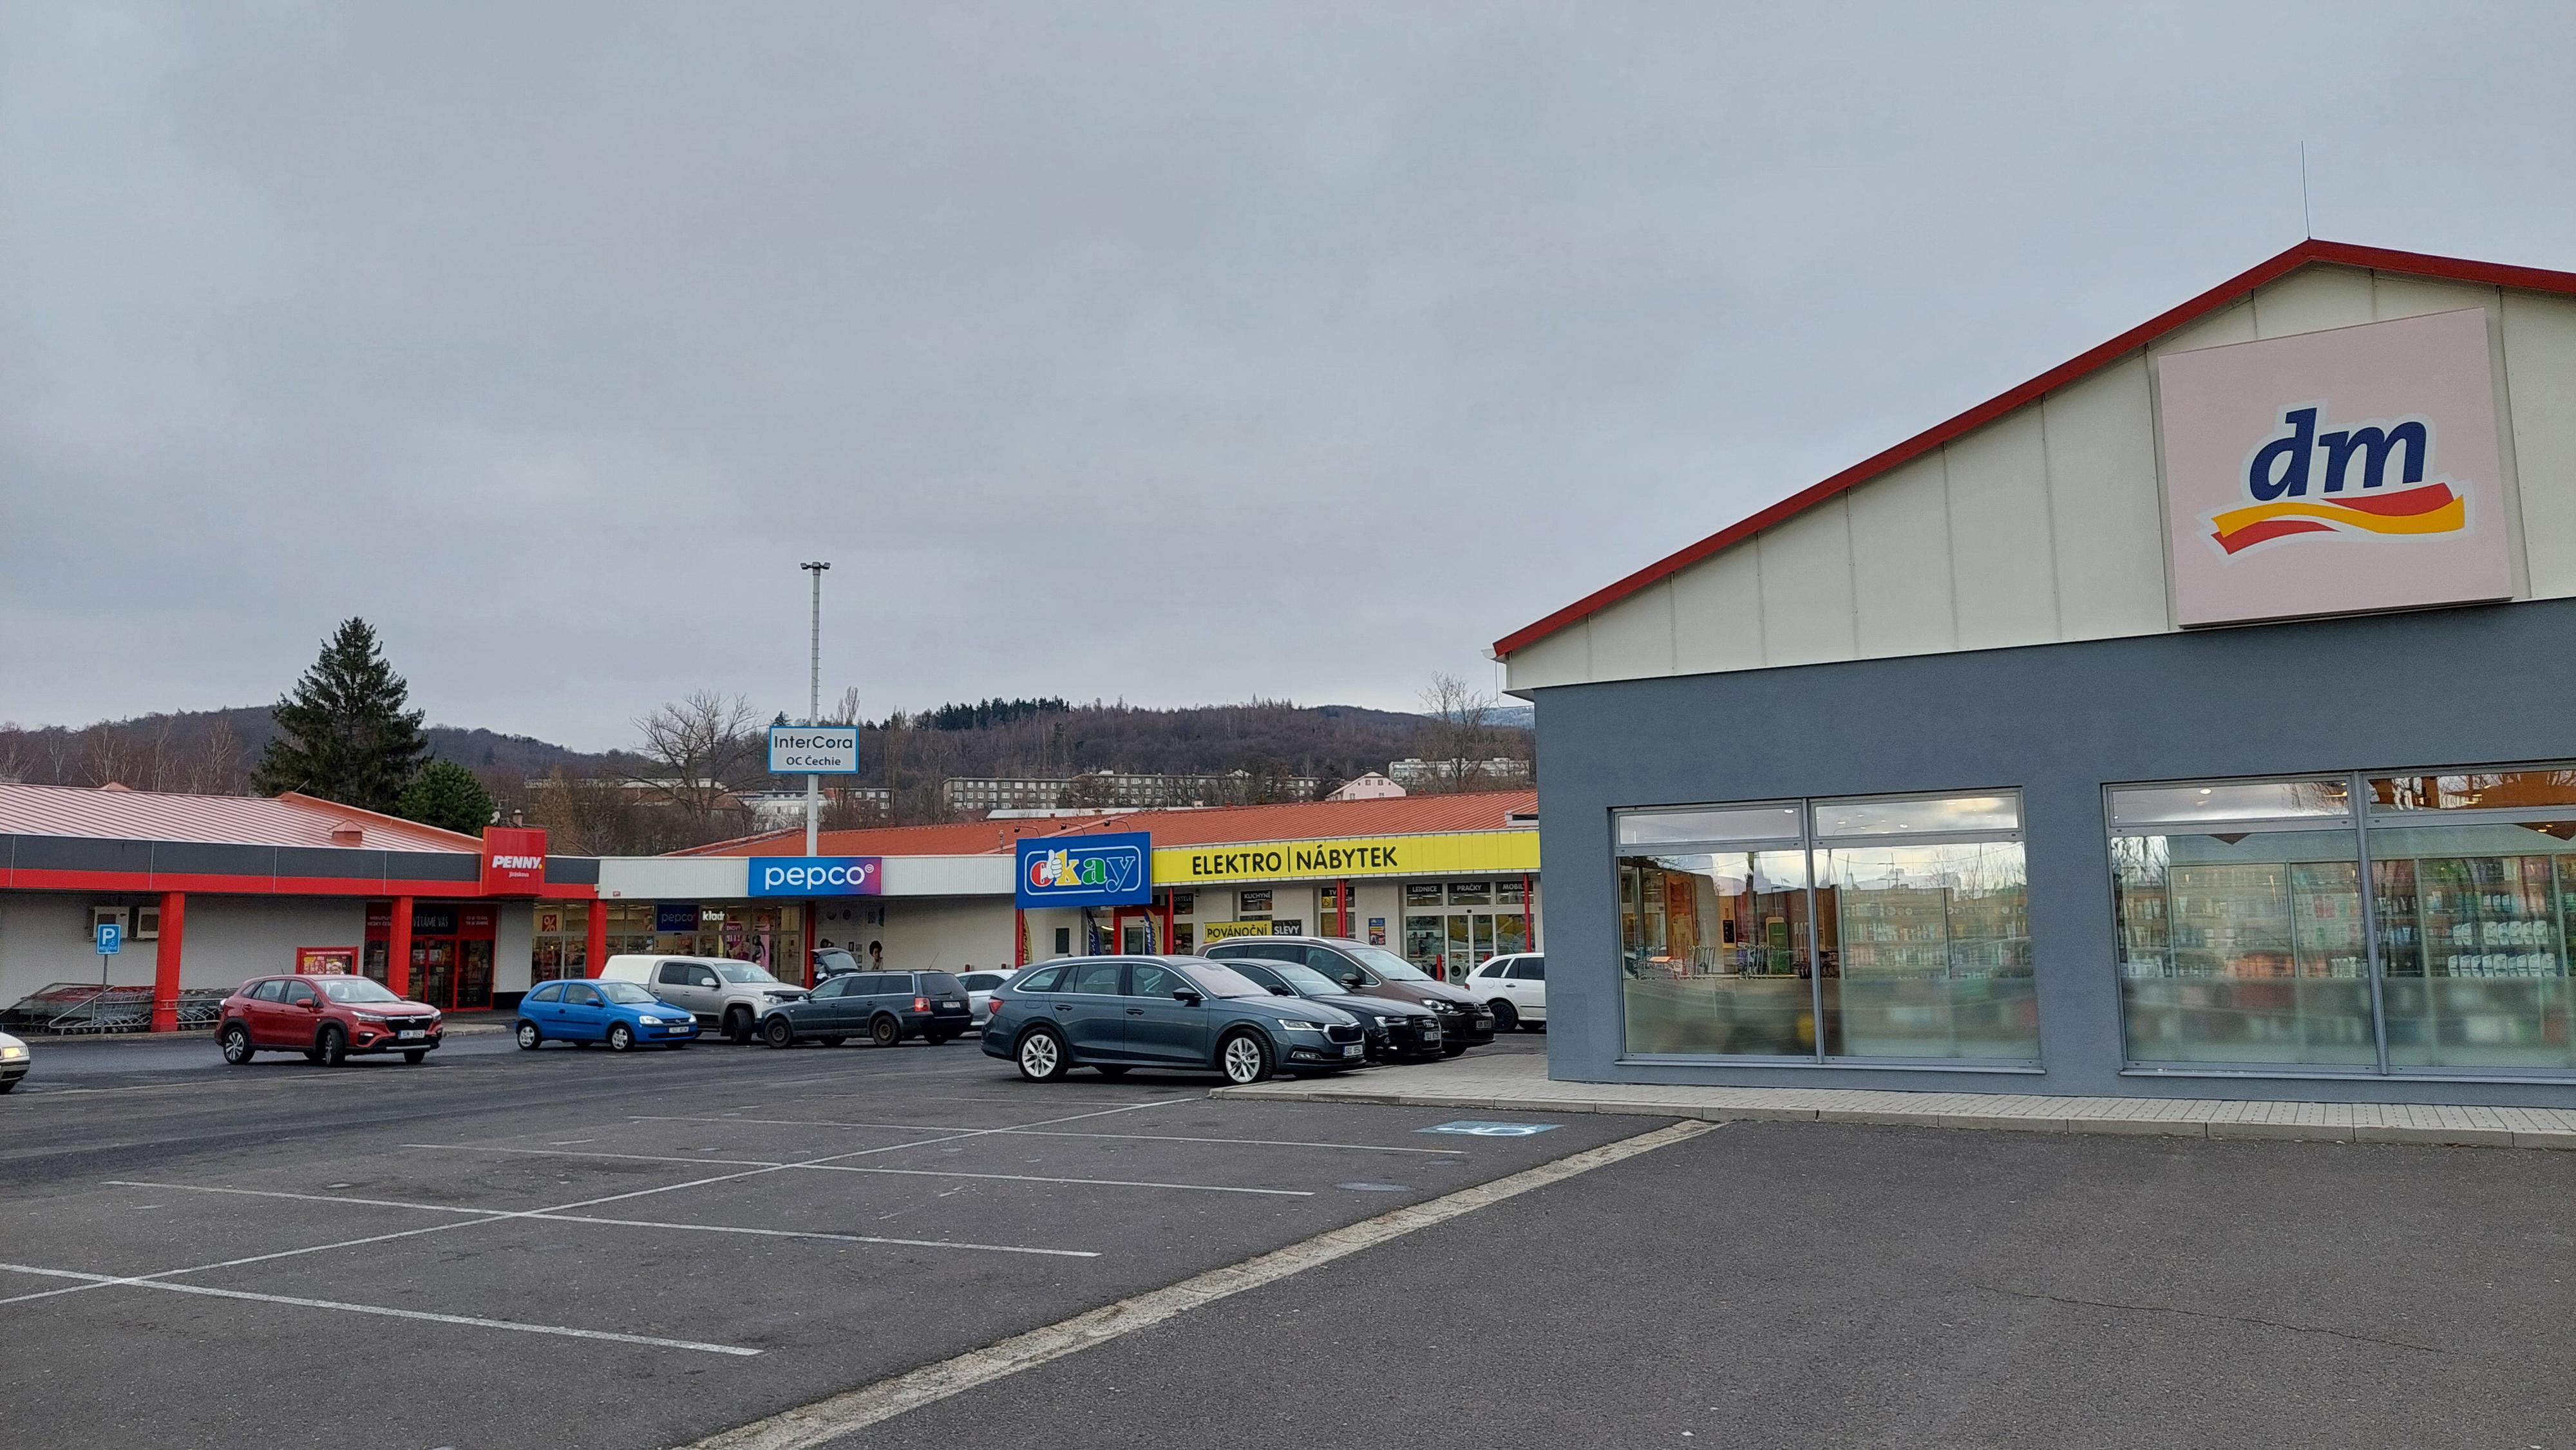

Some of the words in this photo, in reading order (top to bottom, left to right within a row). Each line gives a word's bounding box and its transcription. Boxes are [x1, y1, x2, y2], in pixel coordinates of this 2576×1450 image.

[2249, 407, 2427, 502] dm
[774, 735, 853, 749] InterCora
[786, 756, 802, 766] OC
[805, 755, 841, 766] Čechie
[1192, 851, 1282, 875] ELEKTRO
[1296, 844, 1398, 871] NÁBYTEK
[764, 865, 866, 890] pepco
[1456, 883, 1482, 892] PRAČKY
[412, 914, 437, 928] VÍTÁME
[438, 914, 449, 928] VÁS
[661, 913, 693, 924] pepco
[102, 928, 116, 945] P
[1207, 923, 1268, 938] POVÁNOČNÍ
[1273, 925, 1300, 936] SLEVY
